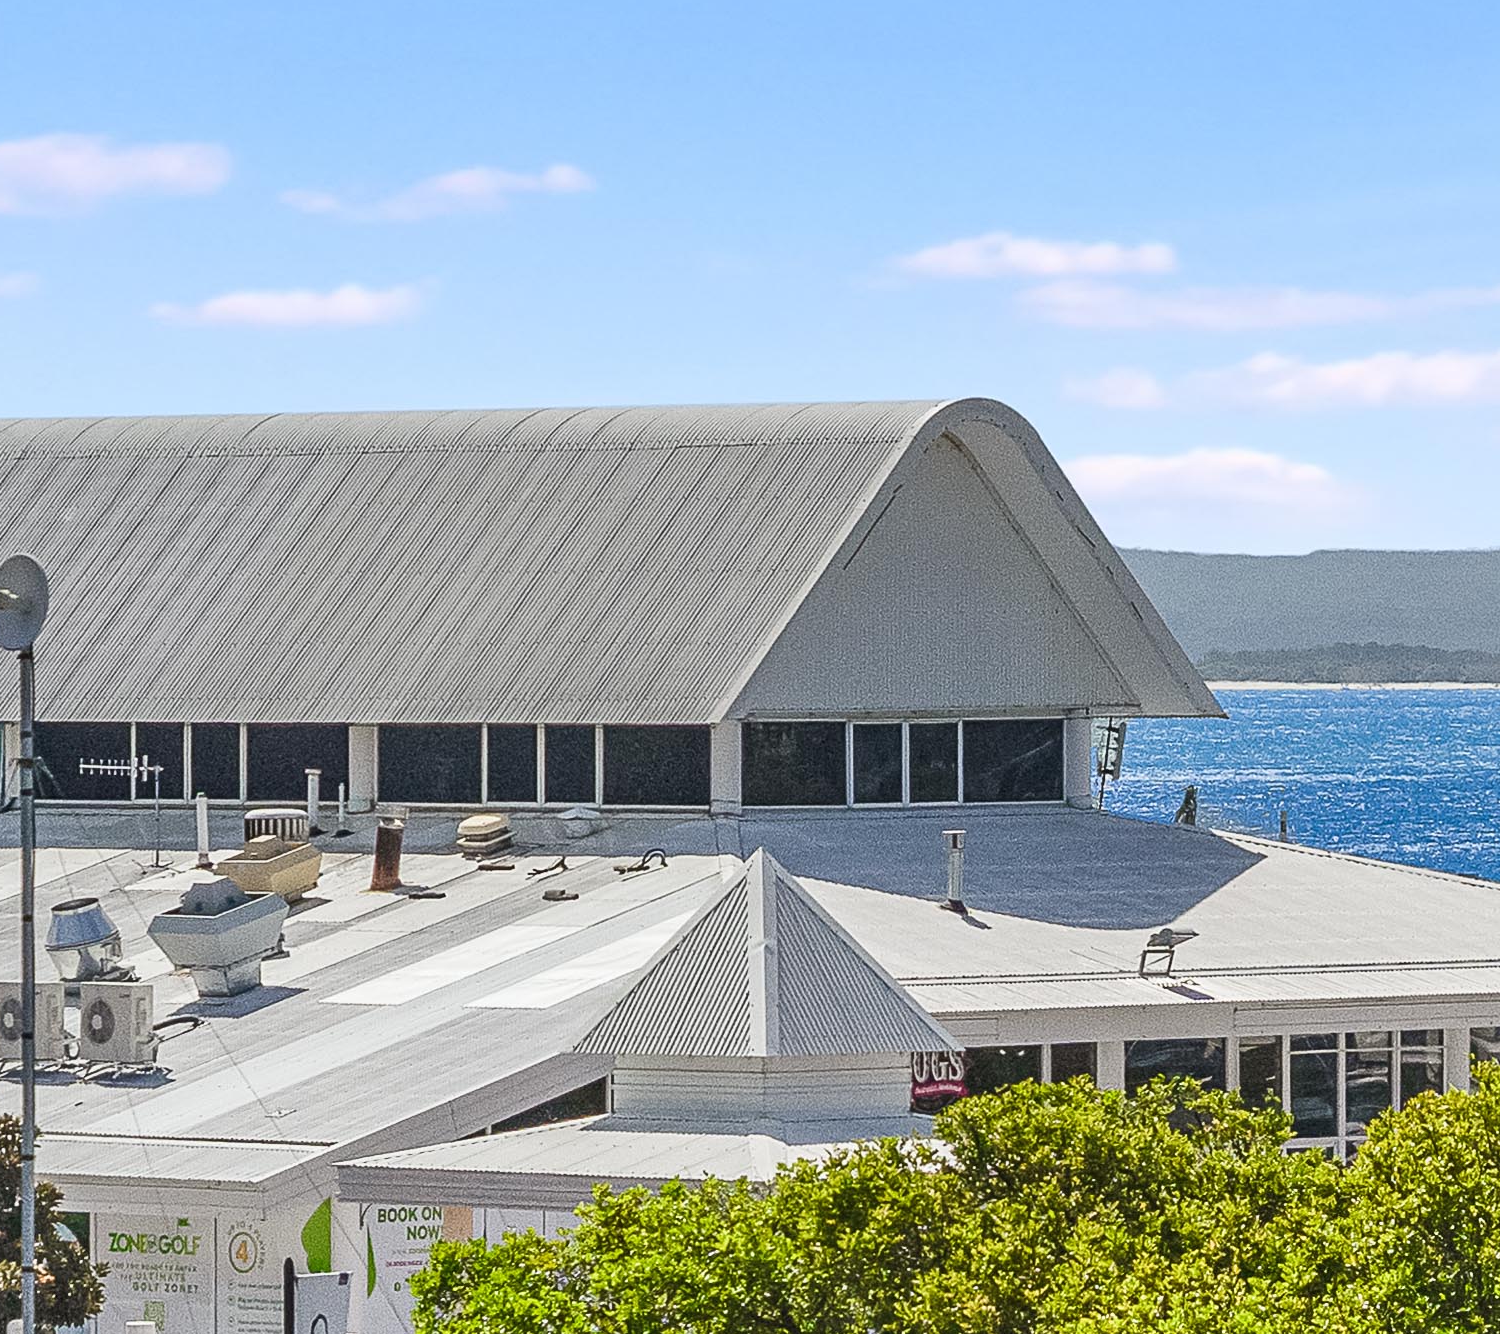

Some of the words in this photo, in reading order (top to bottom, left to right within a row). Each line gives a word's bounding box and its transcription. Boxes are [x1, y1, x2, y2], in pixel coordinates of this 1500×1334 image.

[913, 1050, 964, 1083] OGS
[377, 1207, 418, 1223] BOOK
[235, 1240, 249, 1264] 4
